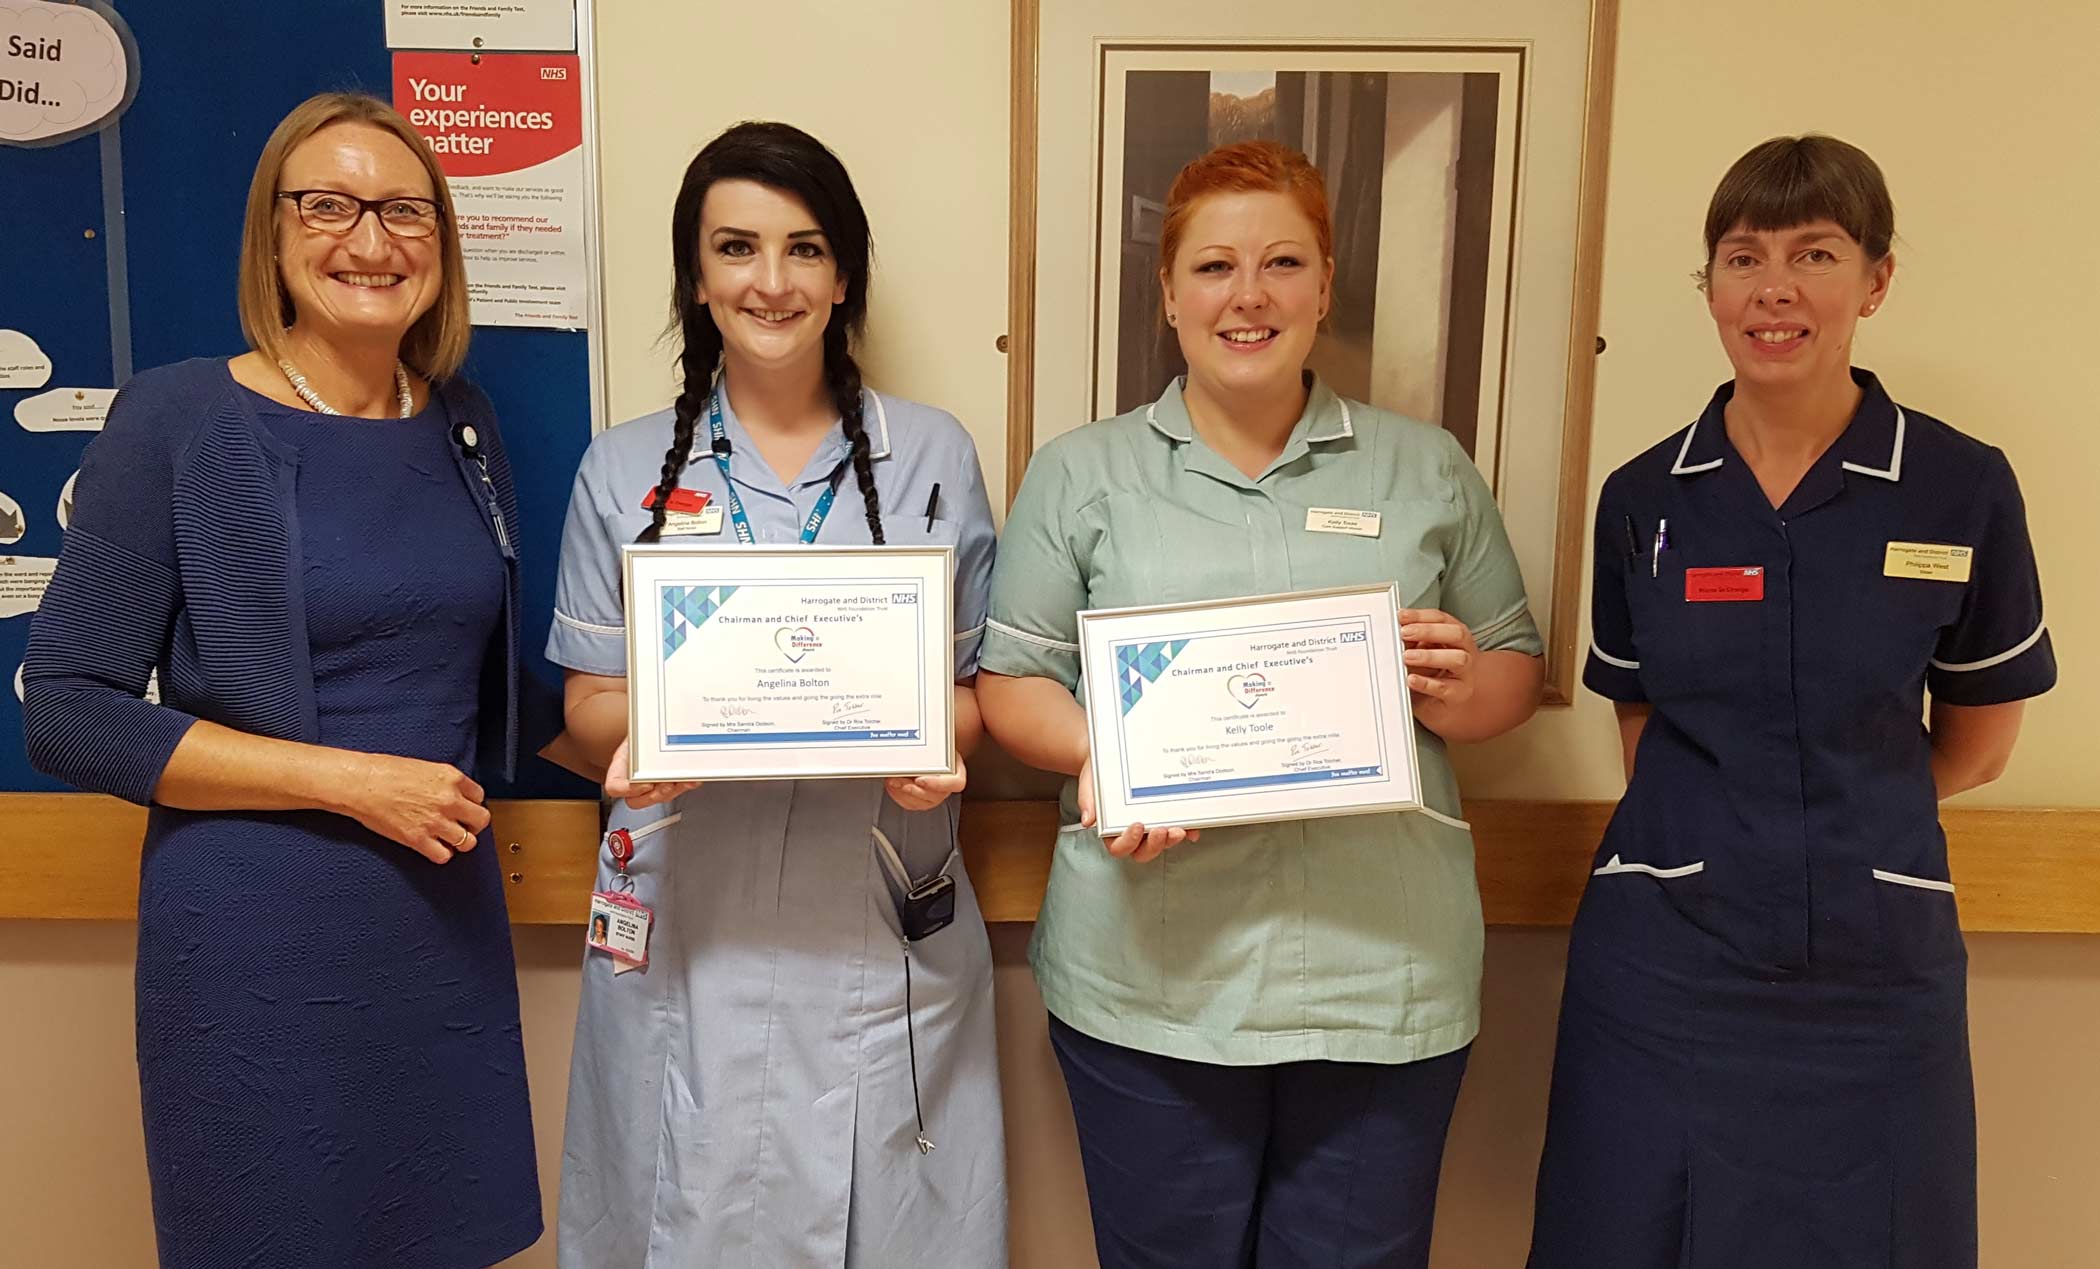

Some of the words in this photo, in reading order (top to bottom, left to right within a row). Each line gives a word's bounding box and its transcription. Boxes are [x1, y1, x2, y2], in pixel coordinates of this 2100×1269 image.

[8, 35, 61, 61] Said
[541, 68, 566, 79] NHS
[0, 80, 60, 106] Did...
[408, 78, 467, 102] Your
[409, 105, 553, 132] experiences
[491, 215, 534, 223] recommend
[486, 223, 508, 232] family
[517, 224, 533, 233] they
[535, 225, 562, 233] needed
[801, 597, 841, 606] Harrogate
[843, 597, 859, 605] and
[860, 596, 888, 605] District
[892, 593, 918, 604] NHS
[719, 615, 763, 624] Chairman
[765, 615, 782, 623] and
[785, 615, 809, 623] Chief
[813, 613, 863, 623] Executive's
[791, 635, 814, 643] Making
[792, 641, 823, 649] Difference
[1250, 642, 1290, 652] Harrogate
[1291, 639, 1306, 648] and
[1308, 637, 1337, 646] District
[1340, 631, 1366, 643] NHS
[1171, 667, 1214, 677] Chairman
[1216, 664, 1233, 673] and
[1235, 661, 1259, 671] Chief
[1263, 656, 1313, 668] Executive's
[757, 679, 797, 690] Angelina
[799, 678, 830, 688] Bolton
[1242, 681, 1266, 689] Making
[1244, 687, 1275, 695] Difference
[1225, 725, 1247, 735] Kelly
[1249, 723, 1274, 733] Toole
